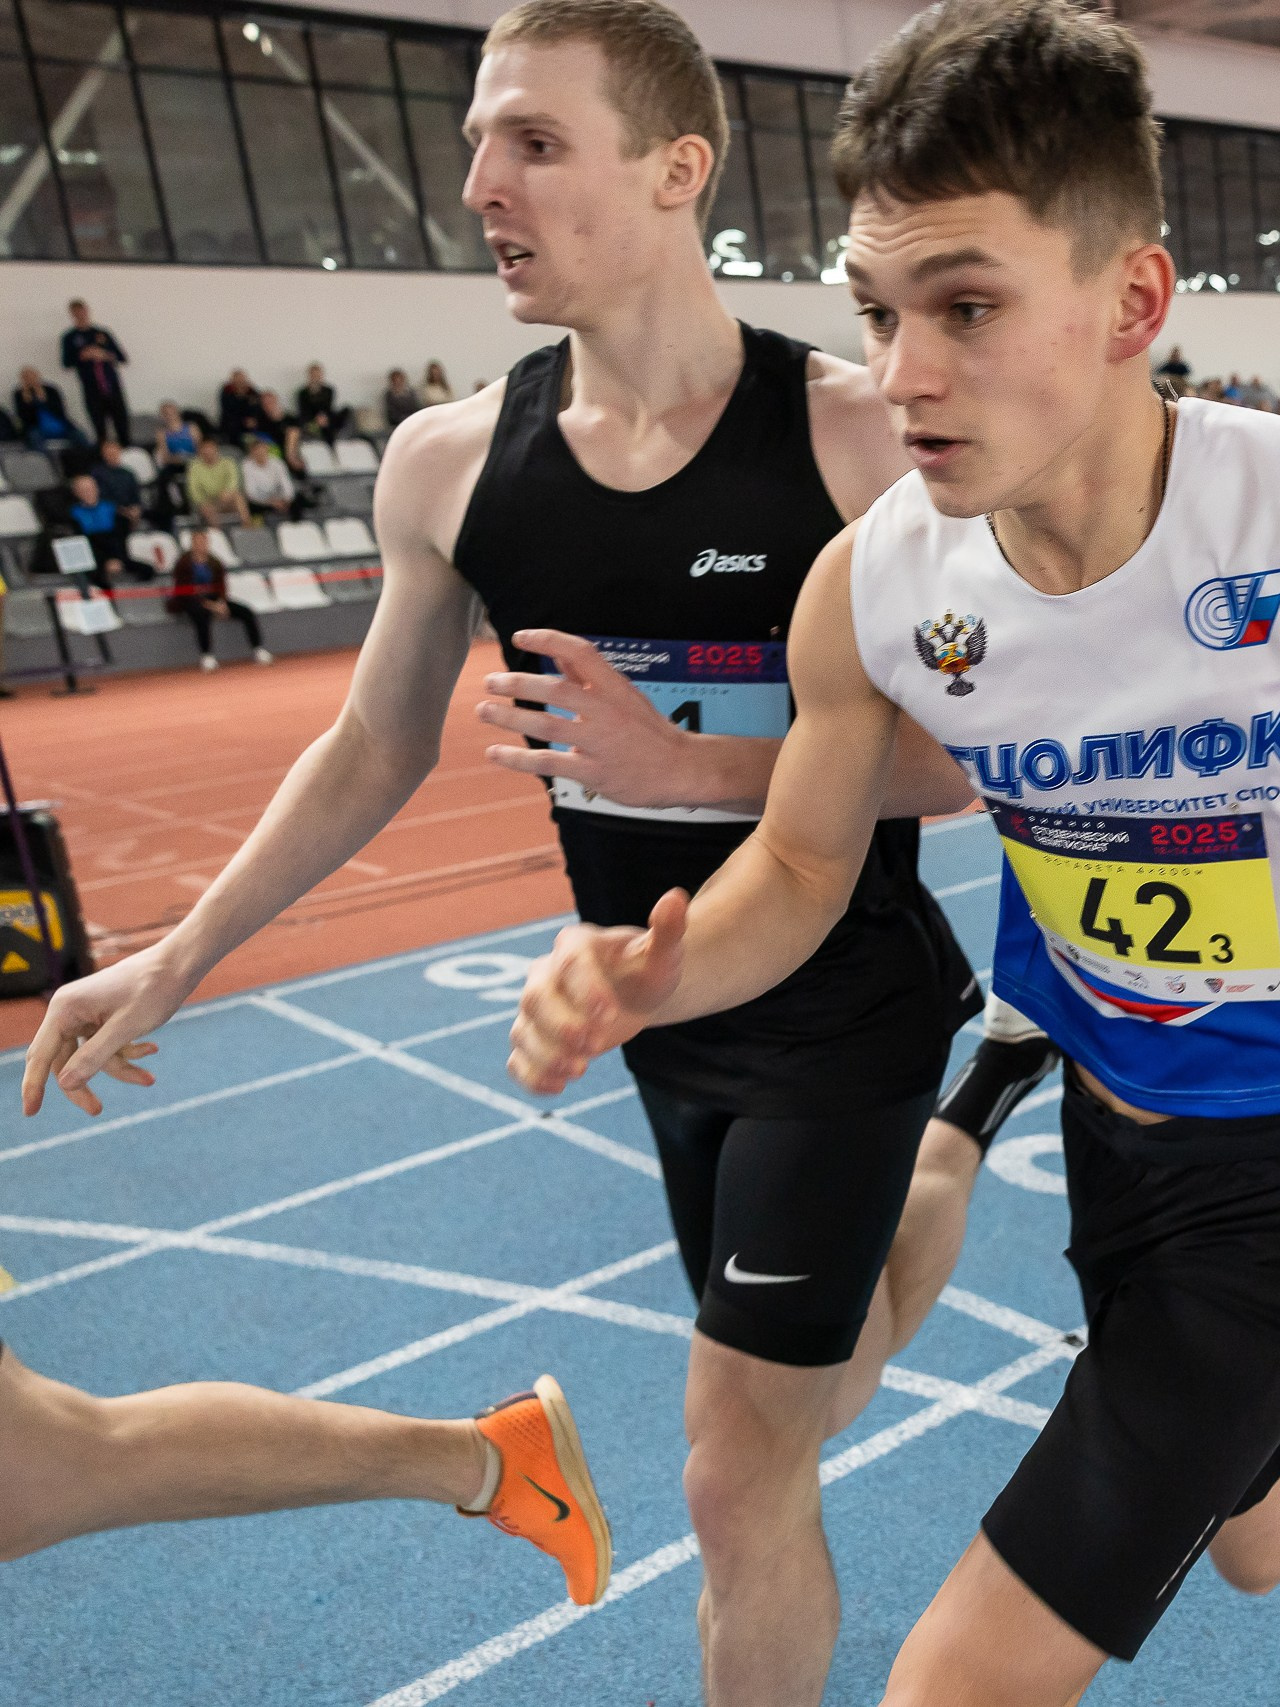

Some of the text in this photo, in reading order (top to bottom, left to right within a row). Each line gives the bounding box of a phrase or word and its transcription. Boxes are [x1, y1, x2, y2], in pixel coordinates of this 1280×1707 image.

[687, 645, 763, 666] 2025
[1083, 792, 1229, 816] УНИВЕРСИТЕТ
[1150, 821, 1239, 846] 2025
[1080, 877, 1234, 964] 42 3
